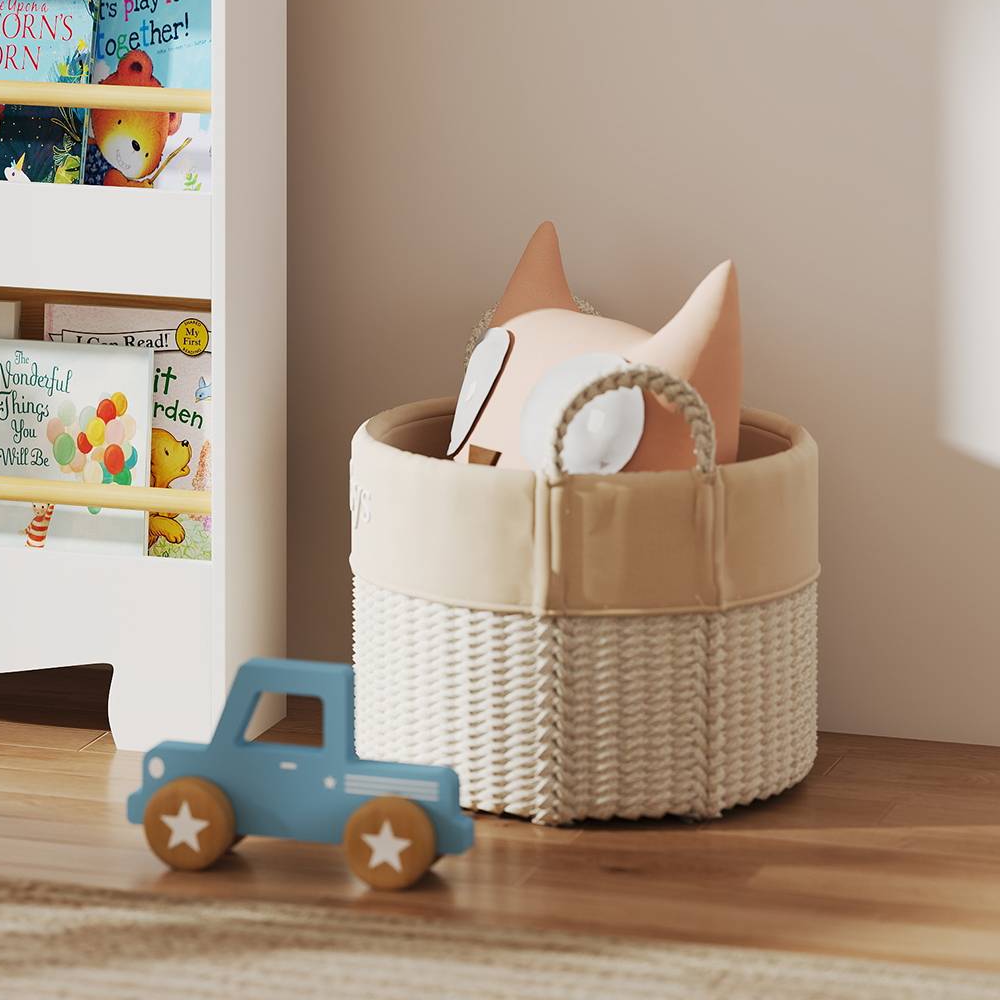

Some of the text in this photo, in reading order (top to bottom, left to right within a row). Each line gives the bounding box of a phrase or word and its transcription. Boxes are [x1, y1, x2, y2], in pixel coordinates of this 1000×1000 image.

[40, 2, 49, 12] a
[95, 12, 189, 60] together!
[123, 333, 169, 348] Read!
[185, 327, 199, 338] My
[183, 337, 201, 346] First
[14, 350, 30, 365] The
[153, 366, 177, 395] it
[153, 400, 203, 429] rden
[10, 420, 37, 444] You
[31, 447, 50, 467] Be
